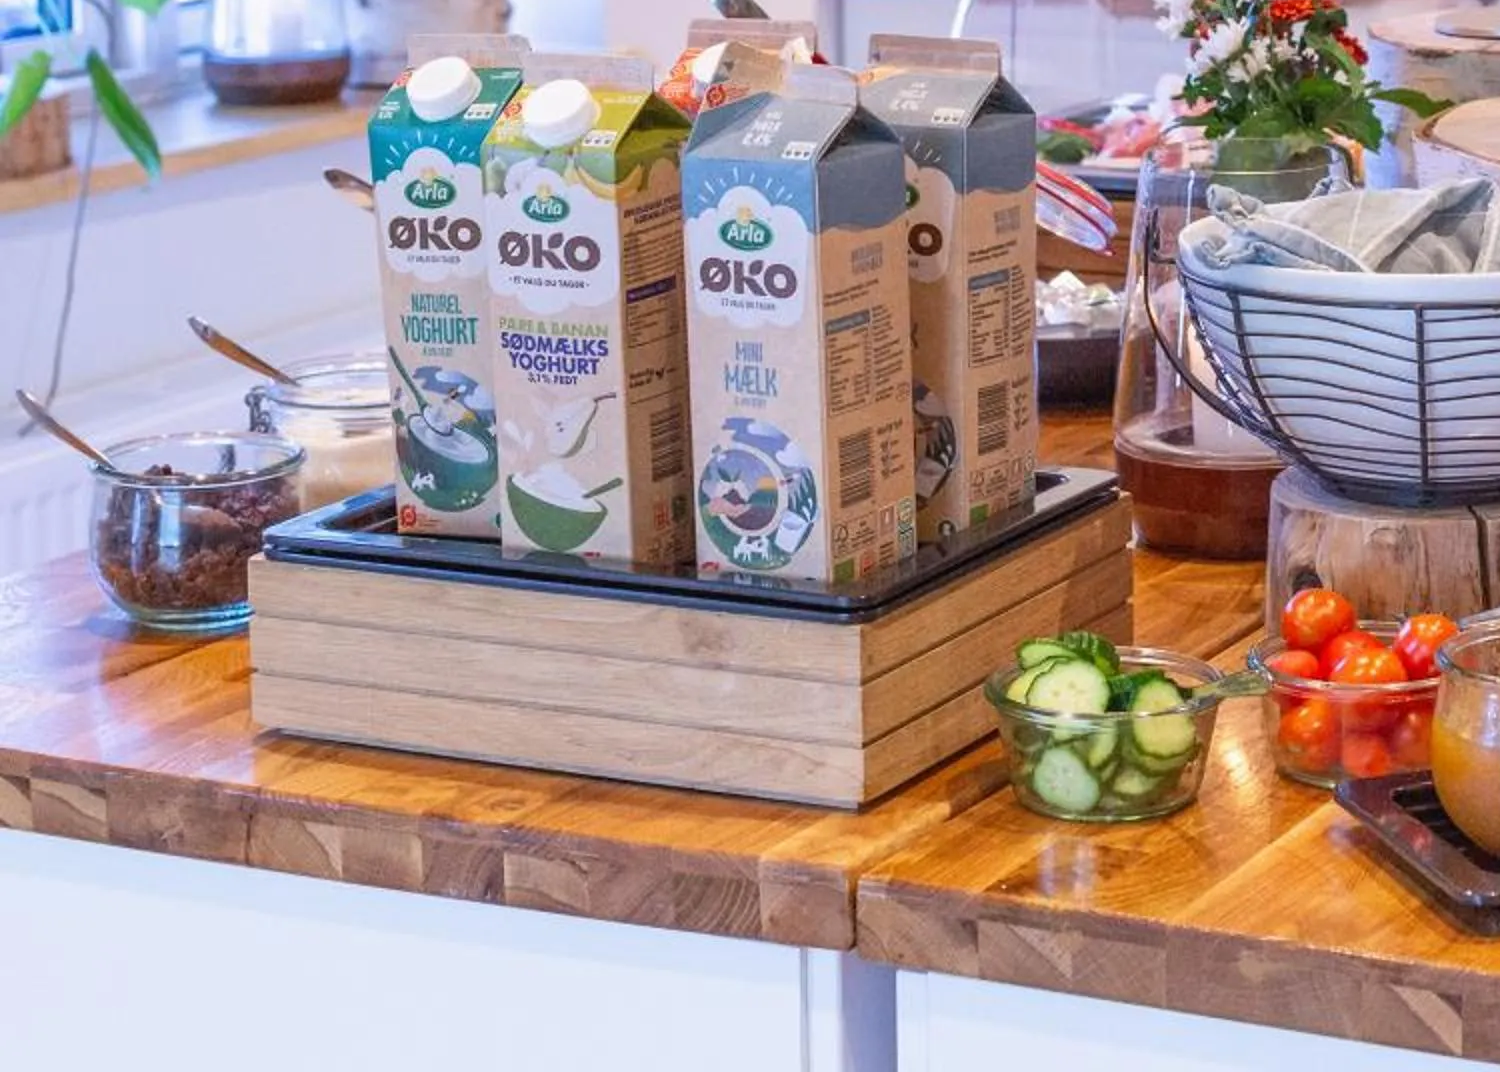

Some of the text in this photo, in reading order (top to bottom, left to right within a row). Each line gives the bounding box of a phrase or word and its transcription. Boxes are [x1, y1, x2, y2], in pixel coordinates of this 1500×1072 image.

[411, 182, 450, 201] Arla
[527, 197, 563, 216] Arla
[388, 215, 482, 252] ØKO
[726, 224, 765, 243] Arla
[498, 231, 602, 272] ØKO
[700, 257, 798, 299] ØKO
[411, 294, 463, 315] NATUREL
[400, 314, 479, 345] YOGHURT
[500, 332, 609, 358] SØDMÆLKS
[509, 351, 600, 376] YOGHURT
[724, 363, 778, 398] MÆLK
